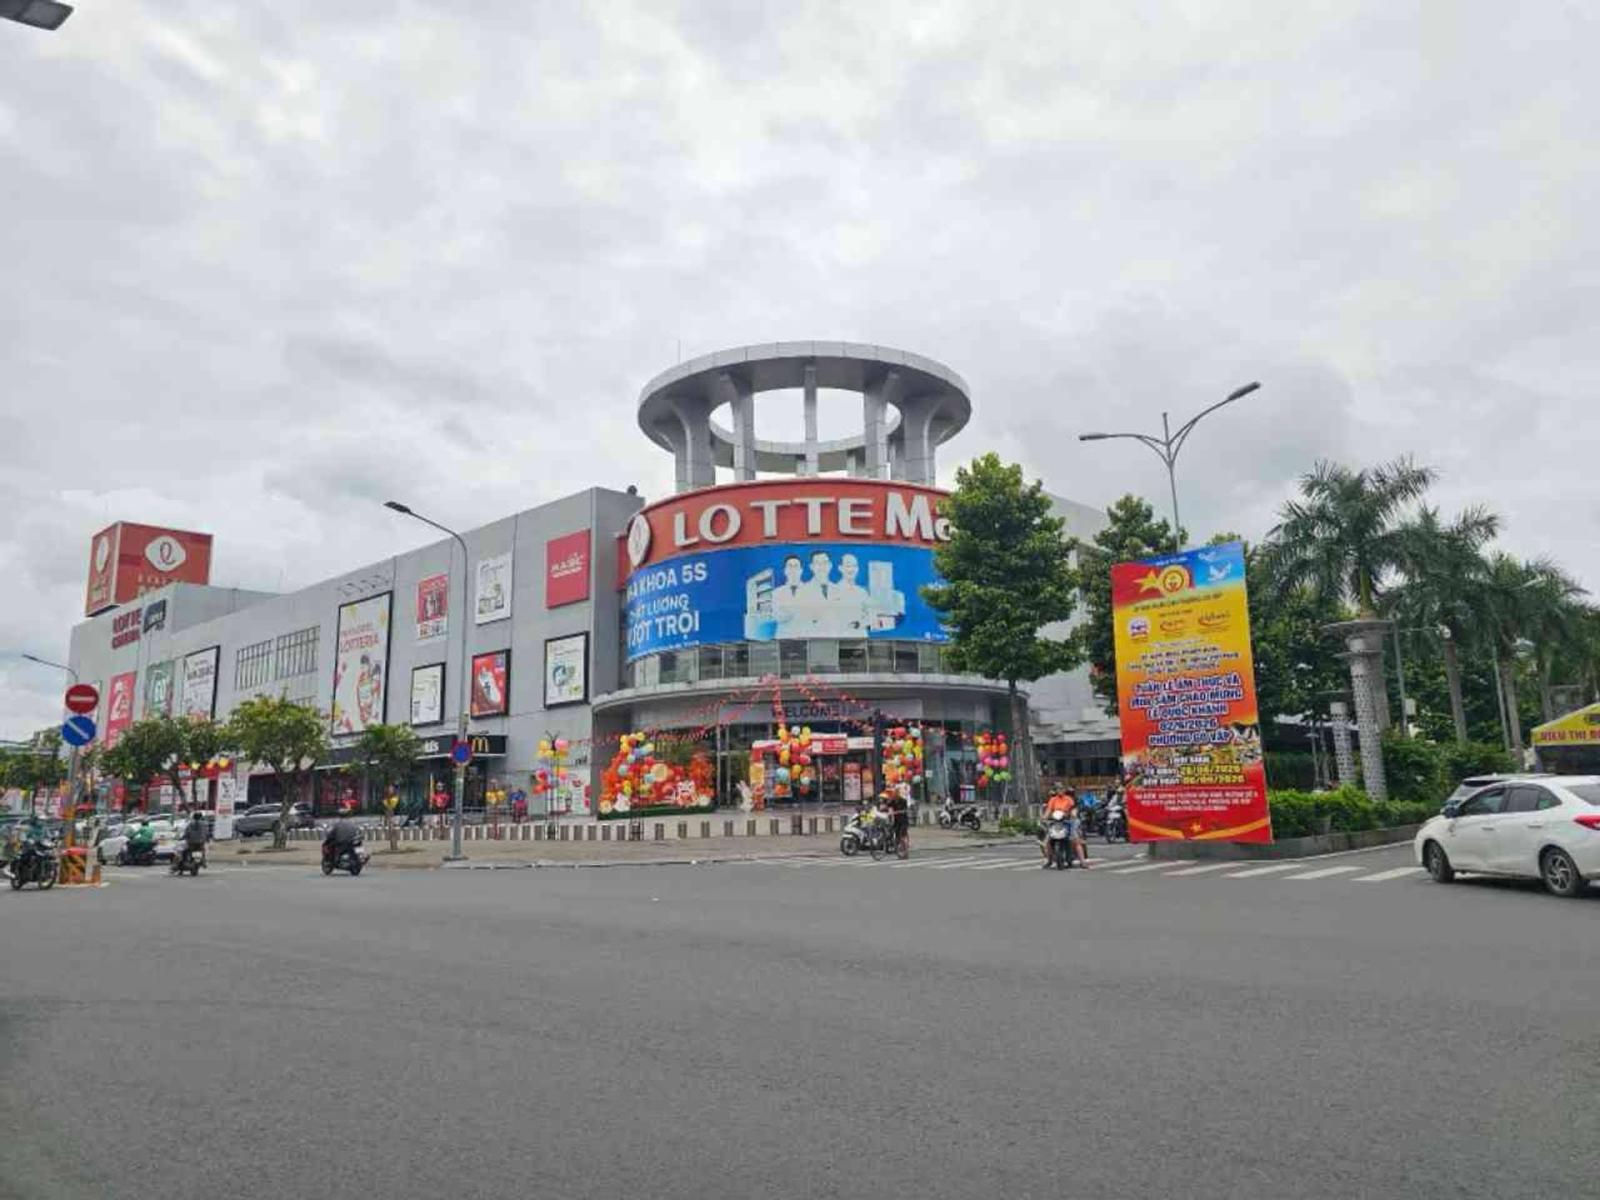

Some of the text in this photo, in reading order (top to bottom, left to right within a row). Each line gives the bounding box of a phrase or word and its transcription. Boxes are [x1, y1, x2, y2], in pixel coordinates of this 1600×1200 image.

[673, 498, 875, 547] LOTTE
[640, 568, 678, 594] KHOA
[682, 561, 707, 584] 5S
